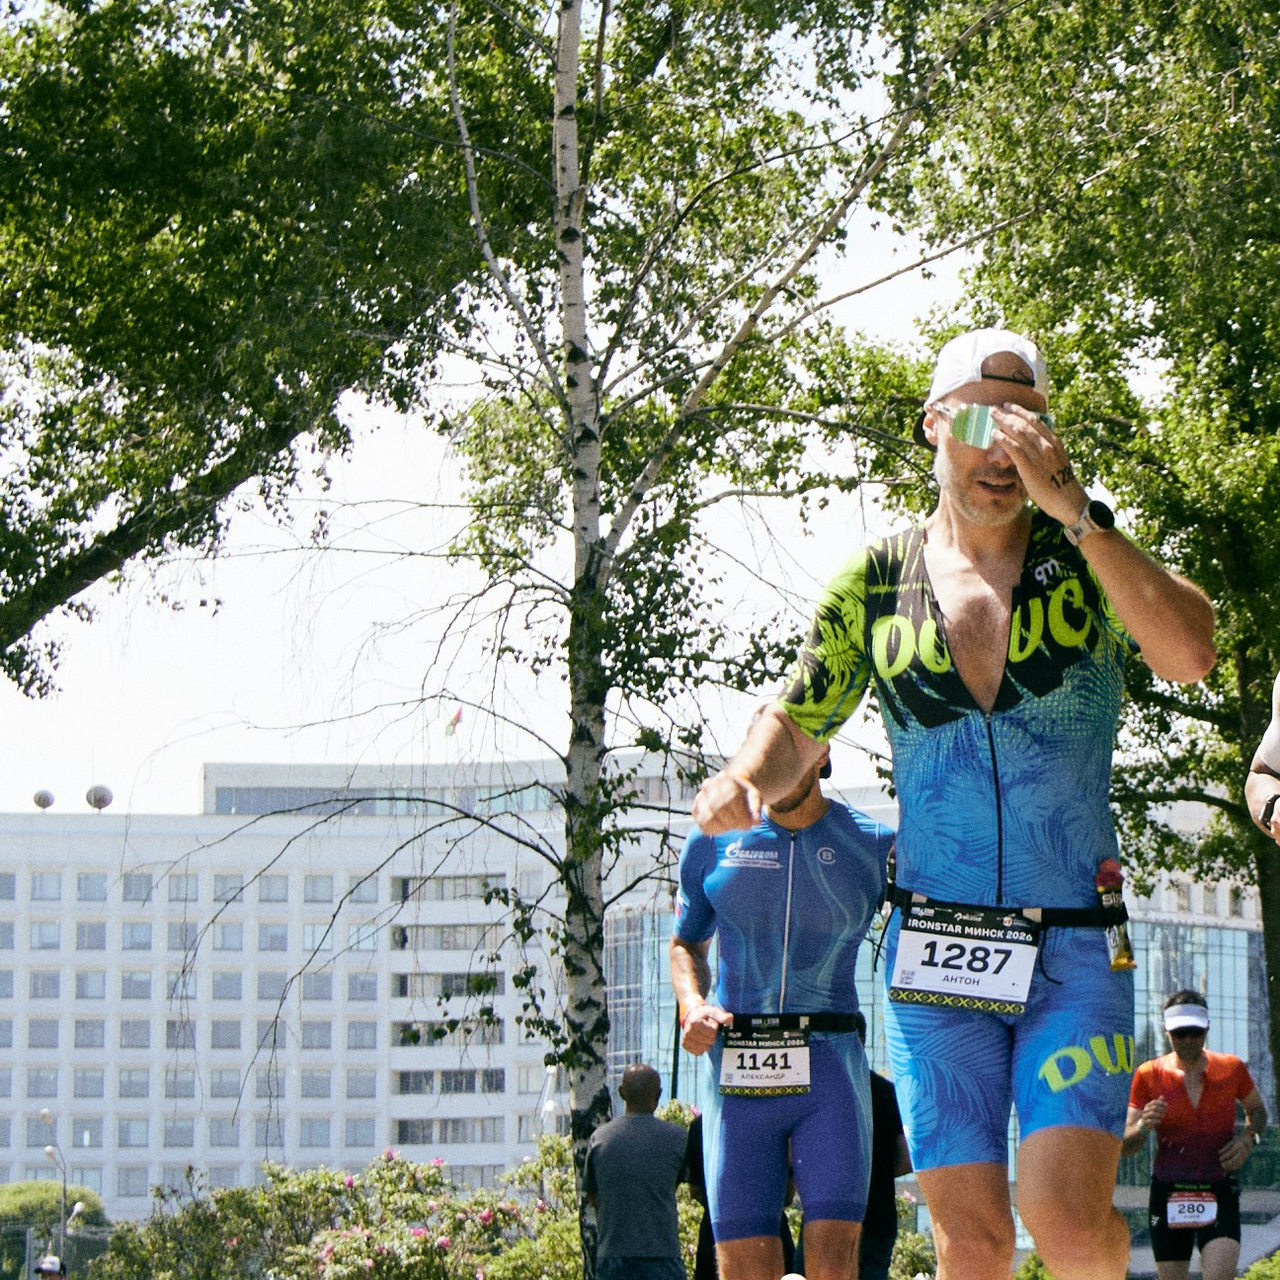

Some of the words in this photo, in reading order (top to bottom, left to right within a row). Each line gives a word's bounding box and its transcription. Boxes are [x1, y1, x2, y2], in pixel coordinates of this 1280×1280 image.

[907, 918, 962, 934] IRONSTAR
[964, 925, 1005, 939] МИНСК
[1005, 929, 1033, 942] 2026
[920, 940, 1013, 975] 1287
[942, 974, 980, 987] АНТОН
[786, 1038, 805, 1046] 2026
[736, 1052, 792, 1070] 1141
[741, 1072, 785, 1080] АЛЕКСАНДР
[1178, 1203, 1205, 1214] 280
